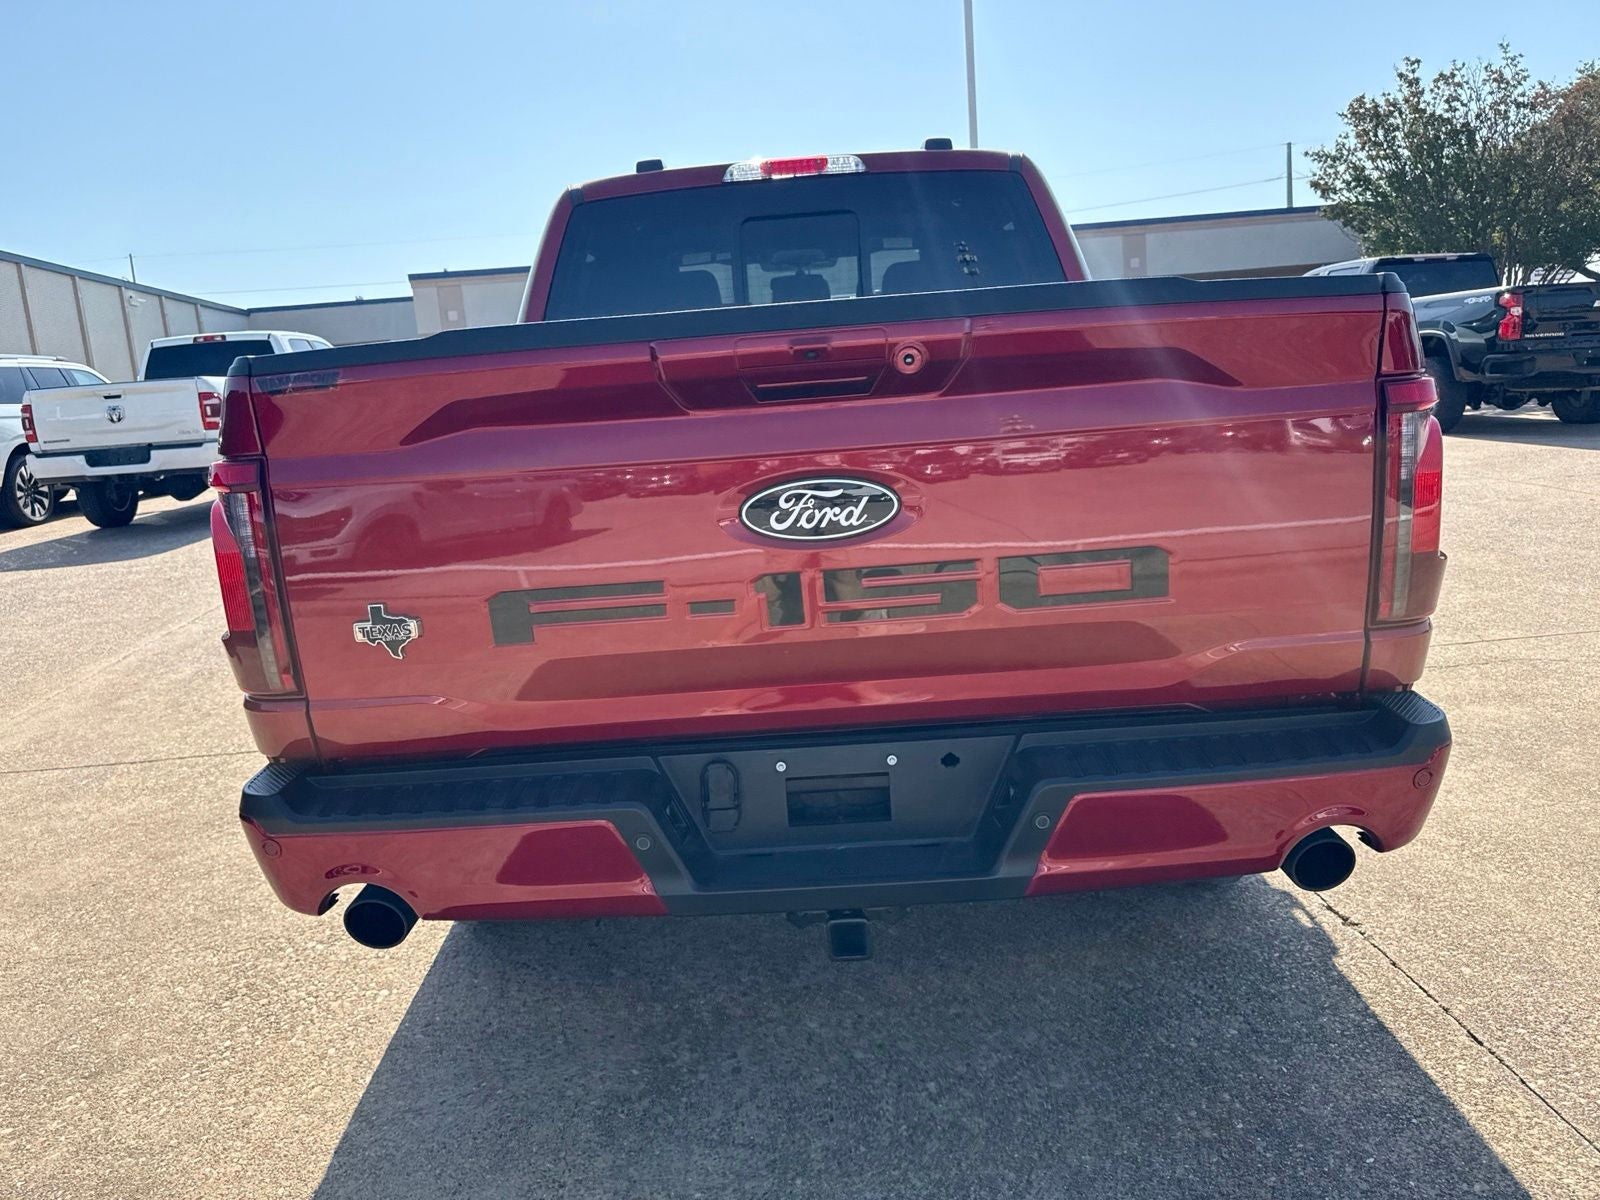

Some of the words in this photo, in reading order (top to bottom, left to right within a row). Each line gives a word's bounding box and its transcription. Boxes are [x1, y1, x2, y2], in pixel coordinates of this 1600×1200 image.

[770, 488, 868, 530] Ford
[488, 546, 1172, 646] F-150
[357, 623, 412, 639] TEXAS
